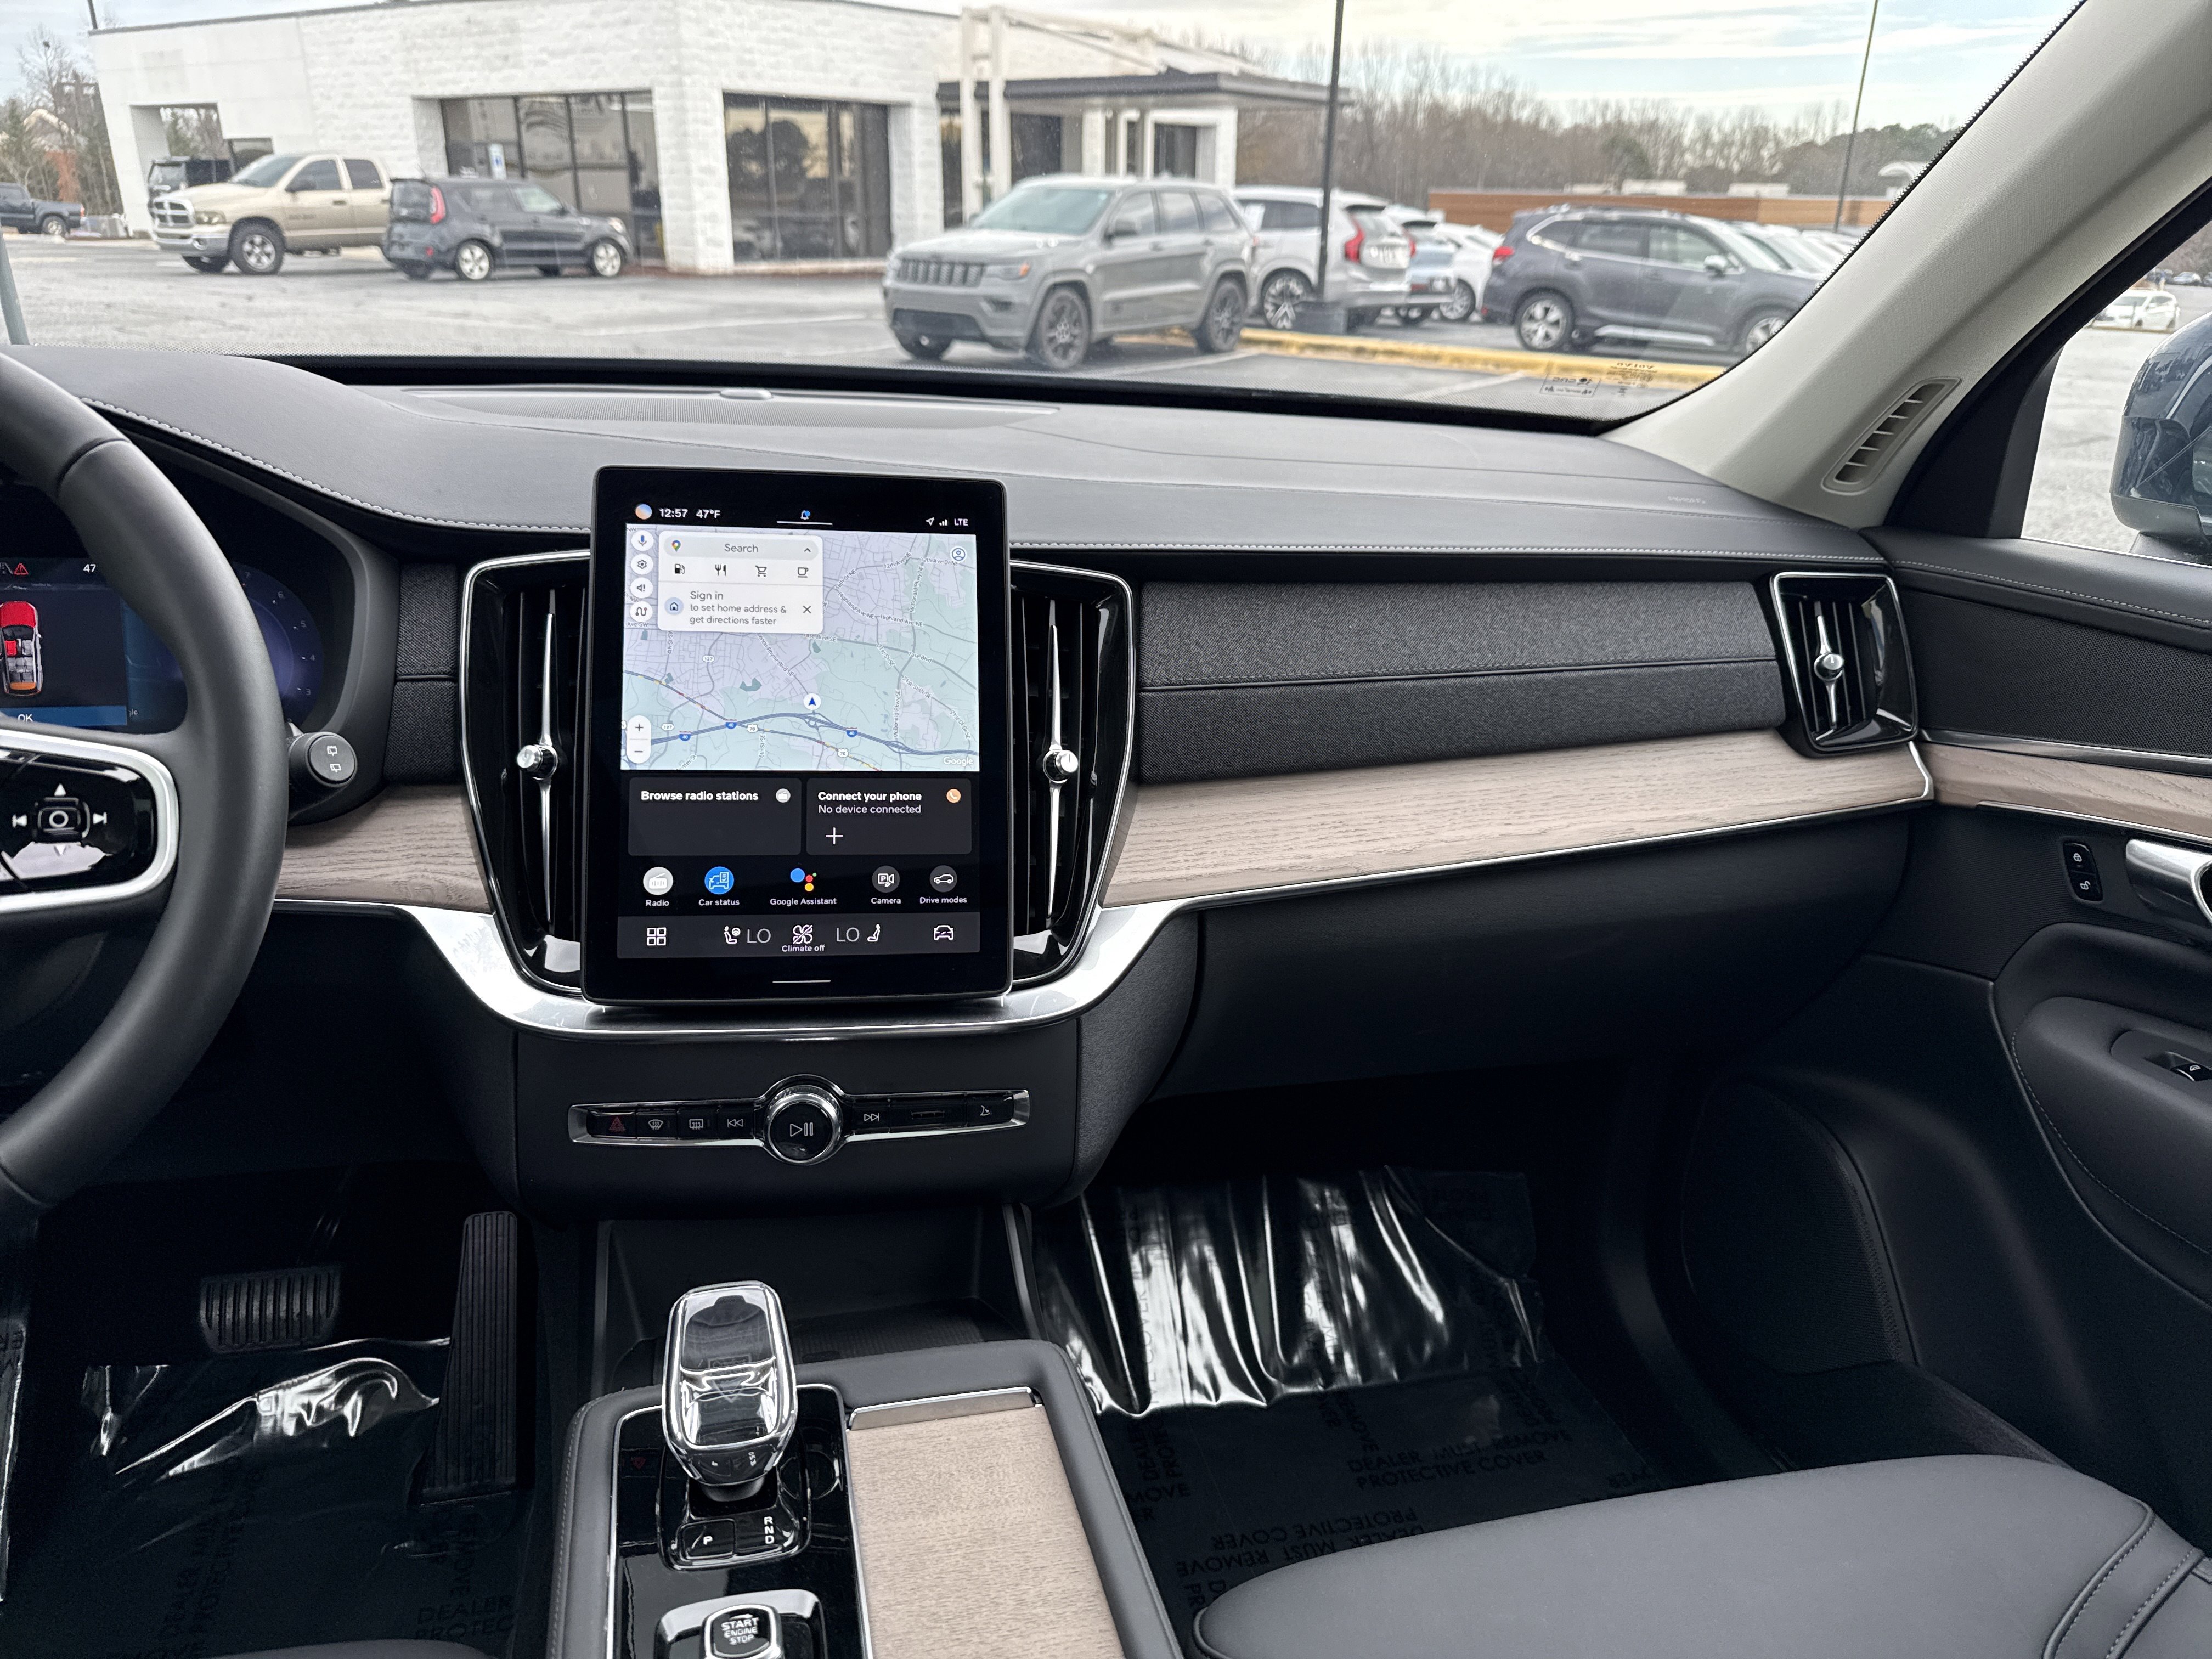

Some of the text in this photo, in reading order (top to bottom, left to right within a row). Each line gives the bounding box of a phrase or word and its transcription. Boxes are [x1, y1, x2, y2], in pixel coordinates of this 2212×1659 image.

[659, 508, 721, 519] 12:57 47°F
[954, 518, 969, 526] LTE
[724, 543, 759, 553] Search
[278, 590, 285, 599] 6
[690, 590, 724, 602] Sign in
[717, 603, 742, 612] home
[743, 605, 778, 613] address
[690, 616, 777, 625] get directions faster
[921, 654, 933, 663] Blvd
[943, 757, 974, 766] Google
[641, 791, 759, 800] Browse radio stations
[817, 791, 922, 803] Connect your phone
[819, 804, 921, 814] No device connected
[770, 898, 799, 907] Google
[747, 928, 771, 944] LO
[836, 927, 860, 942] LO
[781, 944, 825, 952] Climate off
[1347, 1450, 1423, 1474] DEALER
[1356, 1450, 1550, 1491] PROTECTIVE COVER
[763, 1516, 774, 1525] R
[764, 1525, 774, 1534] N
[1213, 1507, 1418, 1551] PROTECTIVE COVER
[703, 1536, 713, 1545] P
[765, 1534, 775, 1544] D
[1176, 1548, 1270, 1578] REMOVE
[720, 1617, 759, 1631] START
[723, 1626, 758, 1639] ENGINE
[729, 1634, 755, 1645] STOP
